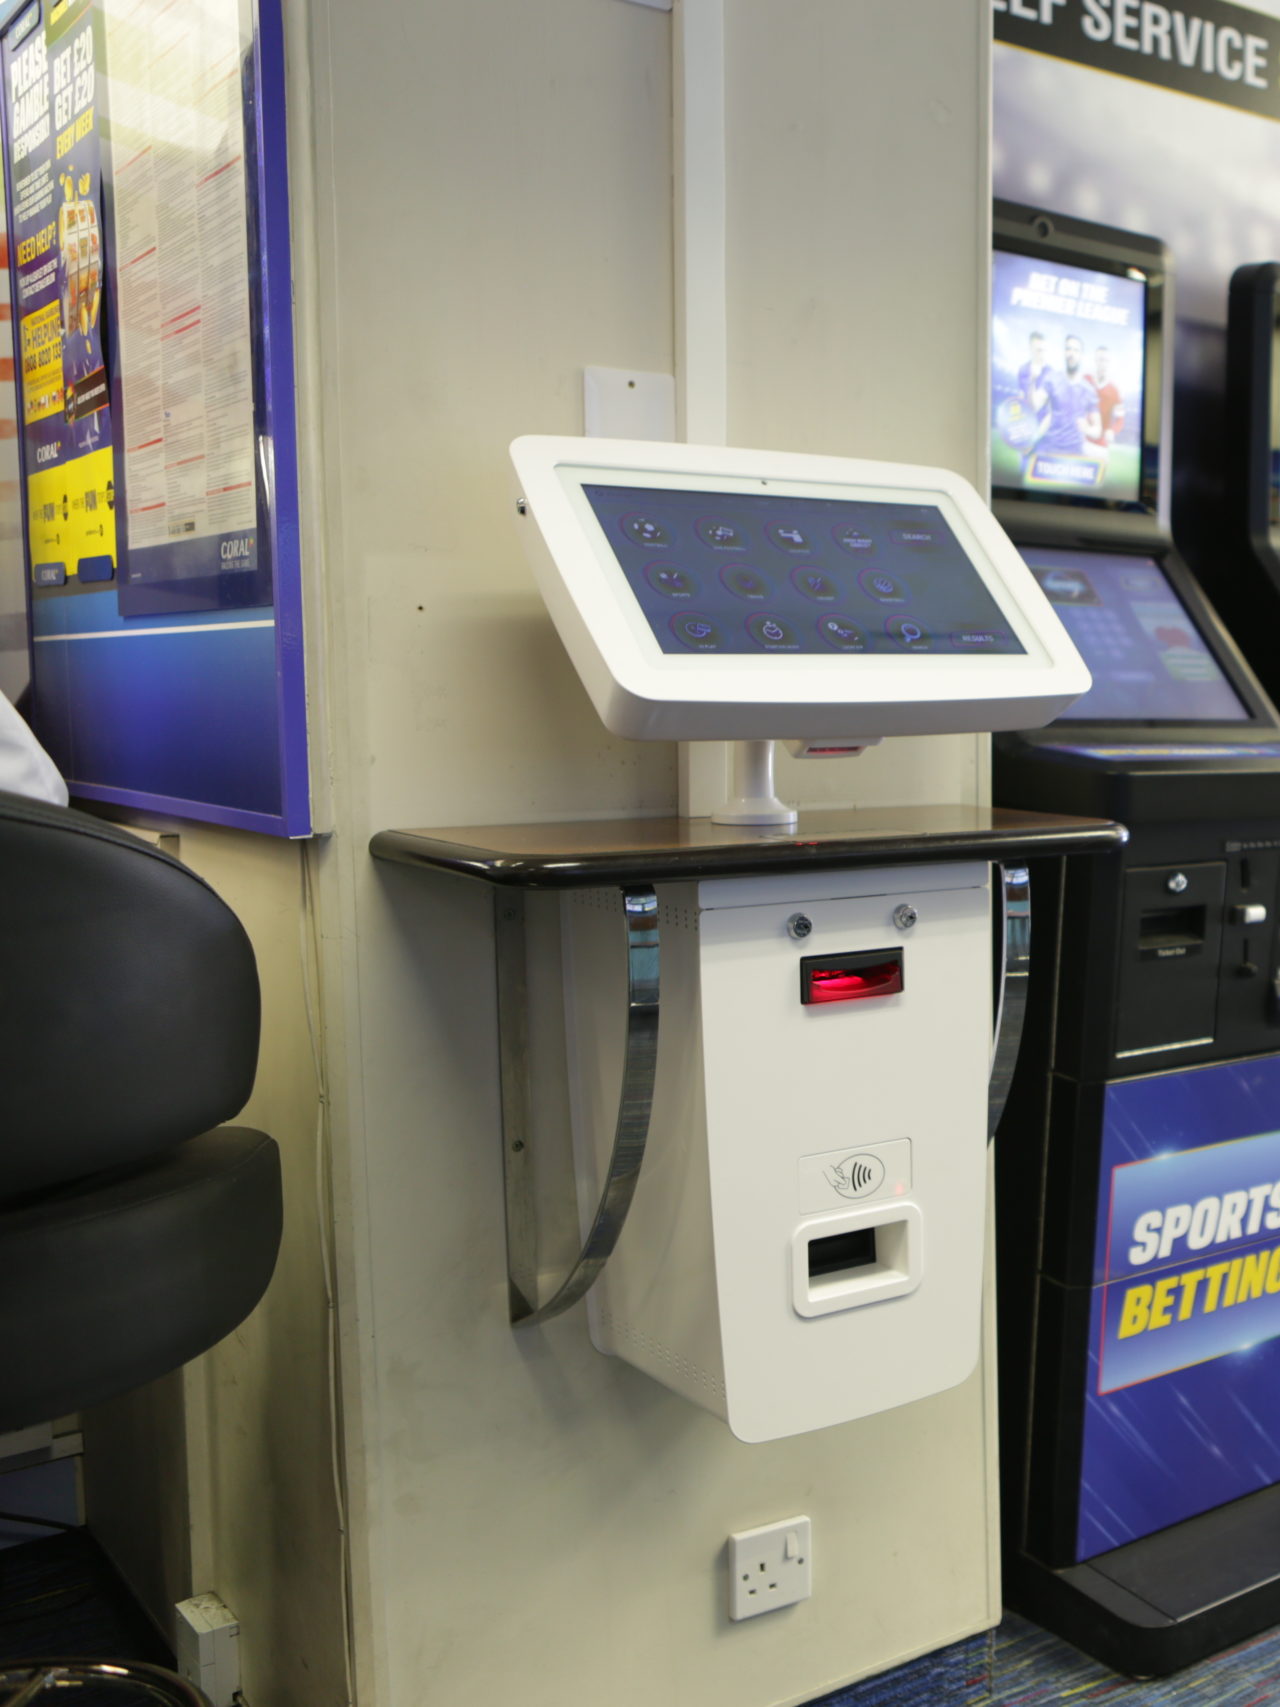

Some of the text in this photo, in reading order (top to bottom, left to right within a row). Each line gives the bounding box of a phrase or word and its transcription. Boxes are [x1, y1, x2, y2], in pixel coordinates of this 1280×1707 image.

[10, 30, 48, 103] PLEASE
[53, 25, 93, 95] BET £20
[1081, 0, 1269, 89] SERVICE
[54, 61, 95, 131] GET £20
[17, 220, 56, 267] NEED HELP?
[36, 442, 58, 464] CORAL
[221, 538, 250, 559] CORAL
